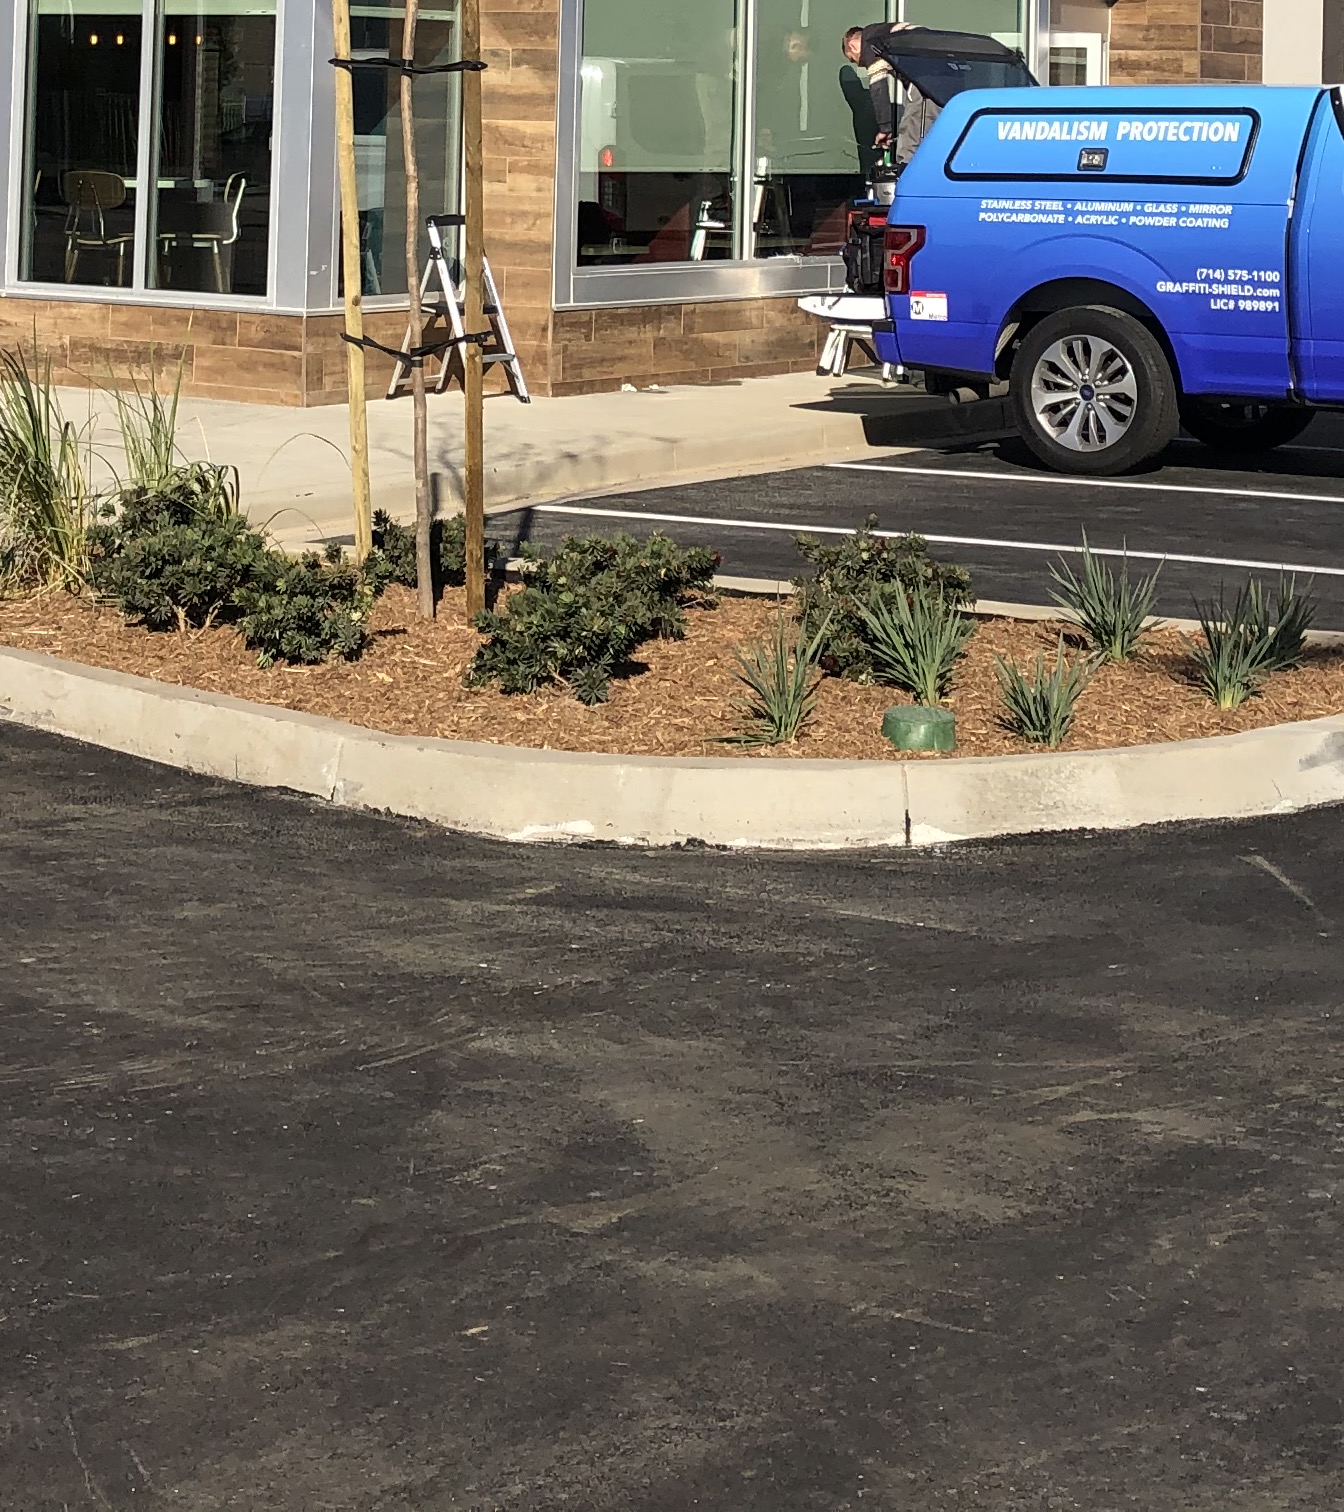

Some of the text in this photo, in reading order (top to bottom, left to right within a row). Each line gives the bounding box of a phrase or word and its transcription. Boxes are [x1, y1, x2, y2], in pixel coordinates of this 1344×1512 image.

[997, 121, 1240, 143] VANDALISM PROTECTION
[980, 199, 1233, 215] STAINLESS STEEL ALUMINUM GLASS MIRROR
[978, 212, 1229, 229] POLYCARBONATE ACRYLIC POWDER COATING
[1196, 268, 1281, 283] (714) 575-1100
[1156, 281, 1281, 297] GRAFFITI-SHIELD.com
[1210, 298, 1280, 312] LIC# 989891
